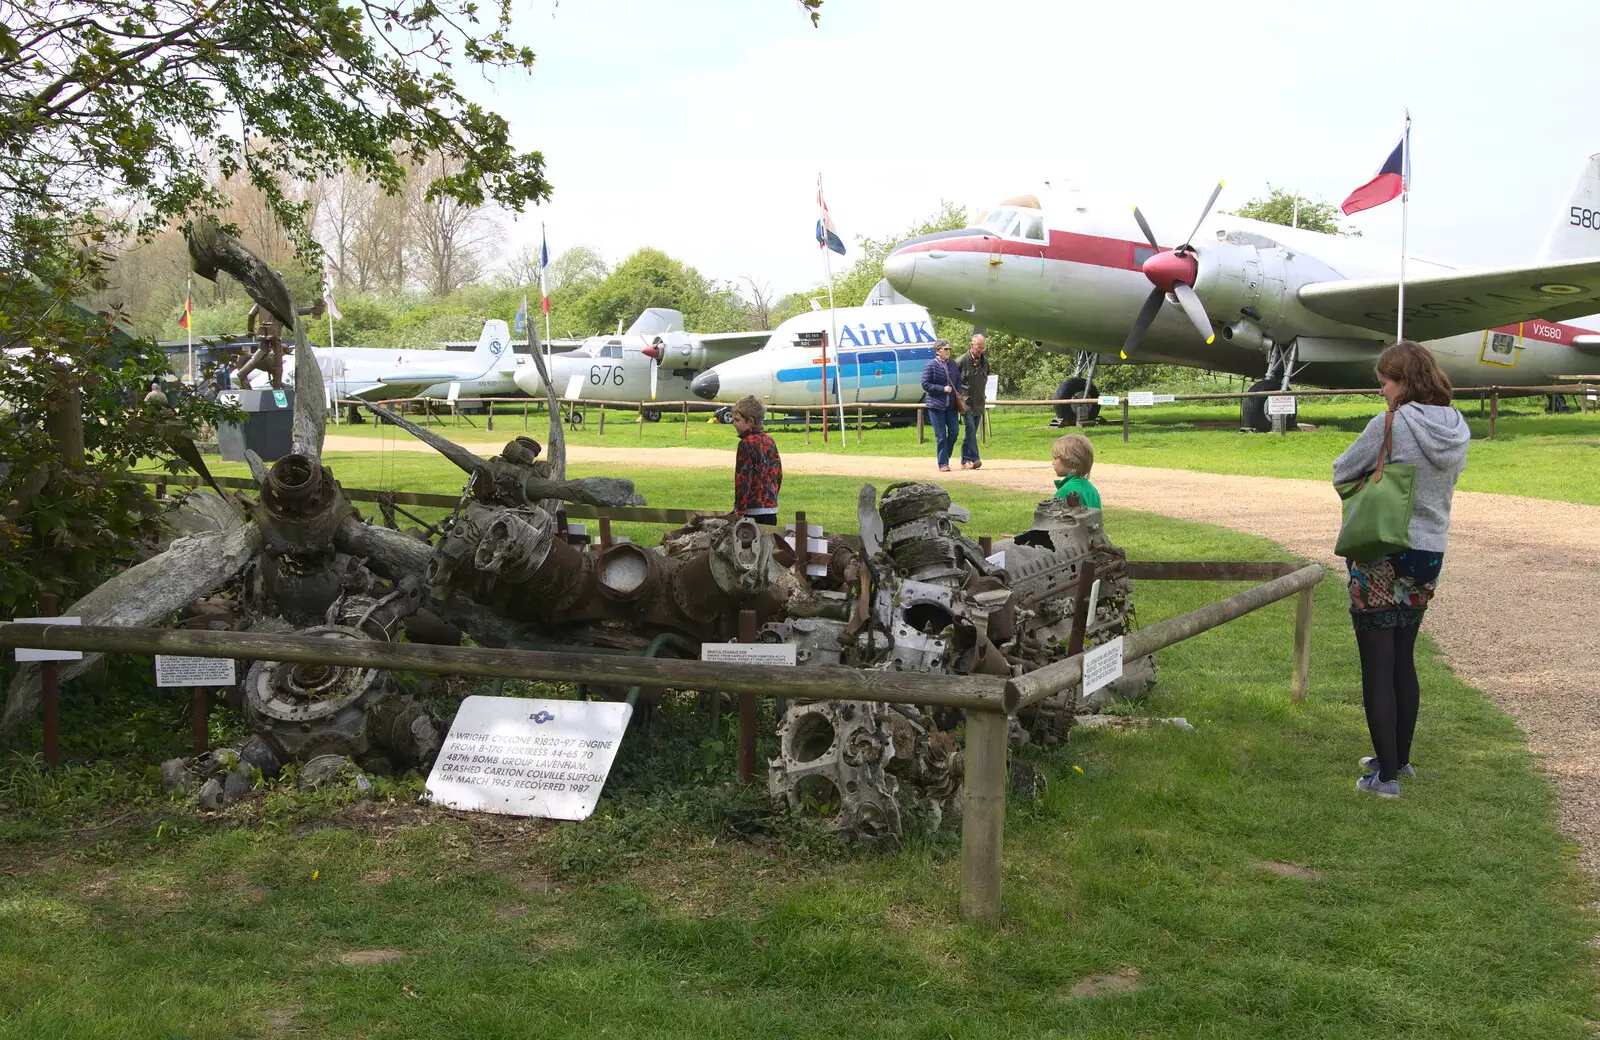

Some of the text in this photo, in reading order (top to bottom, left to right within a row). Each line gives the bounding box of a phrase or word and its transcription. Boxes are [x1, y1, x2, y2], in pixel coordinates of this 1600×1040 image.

[1570, 206, 1600, 230] 580
[1533, 322, 1563, 341] VX580
[590, 364, 625, 386] 676
[450, 743, 476, 752] FROM
[478, 745, 503, 754] B-17G
[506, 746, 548, 757] FORTRESS
[456, 732, 489, 743] WRIGHT
[492, 734, 532, 746] CYCLONE
[578, 740, 613, 750] ENGINE
[446, 753, 470, 763] 487th
[472, 755, 499, 764] BOMB
[501, 757, 533, 767] GROUP
[441, 763, 481, 774] CRASHED
[483, 766, 524, 777] CARLTON
[566, 772, 605, 783] SUFFOLK
[455, 775, 489, 786] MARCH
[491, 778, 511, 788] 1945
[513, 780, 565, 791] RECOVERED
[569, 784, 591, 793] 1987
